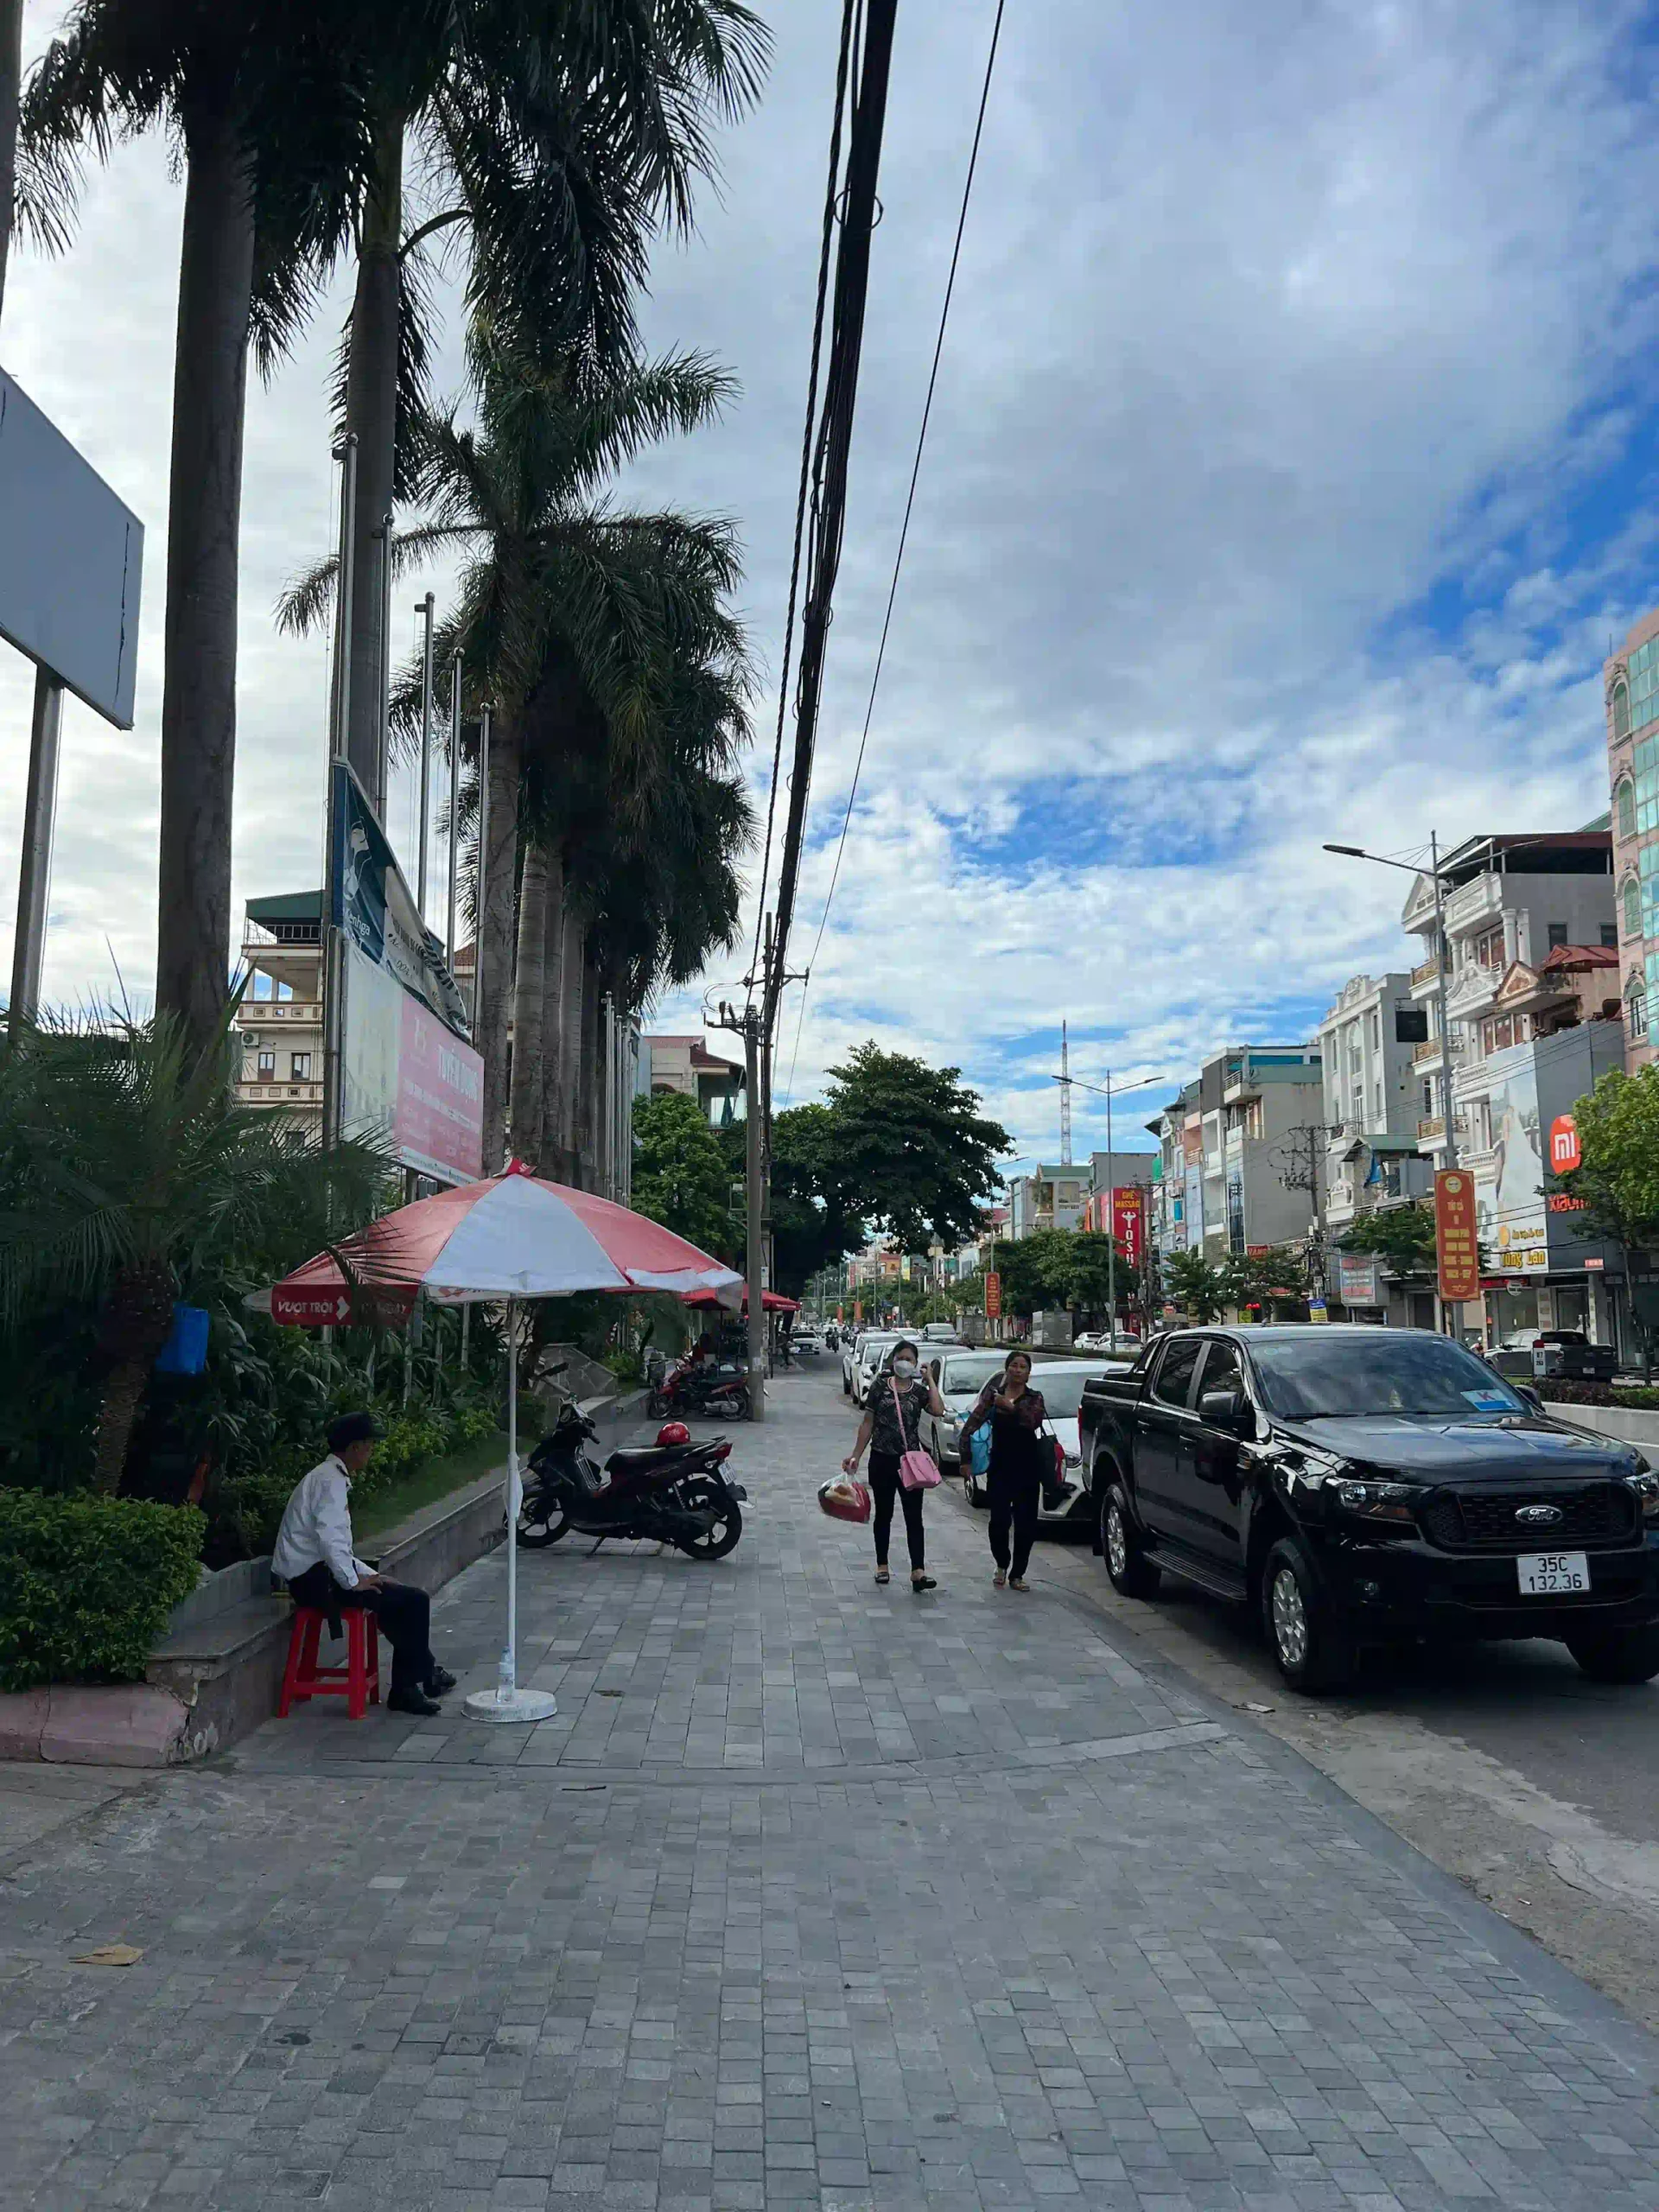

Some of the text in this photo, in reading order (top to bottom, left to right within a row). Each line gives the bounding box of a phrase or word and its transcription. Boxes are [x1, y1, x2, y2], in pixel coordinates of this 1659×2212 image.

[1115, 1200, 1141, 1209] MASSAG
[1528, 1508, 1554, 1521] Ford
[1537, 1556, 1568, 1573] 35C
[1529, 1573, 1582, 1592] 132.36
